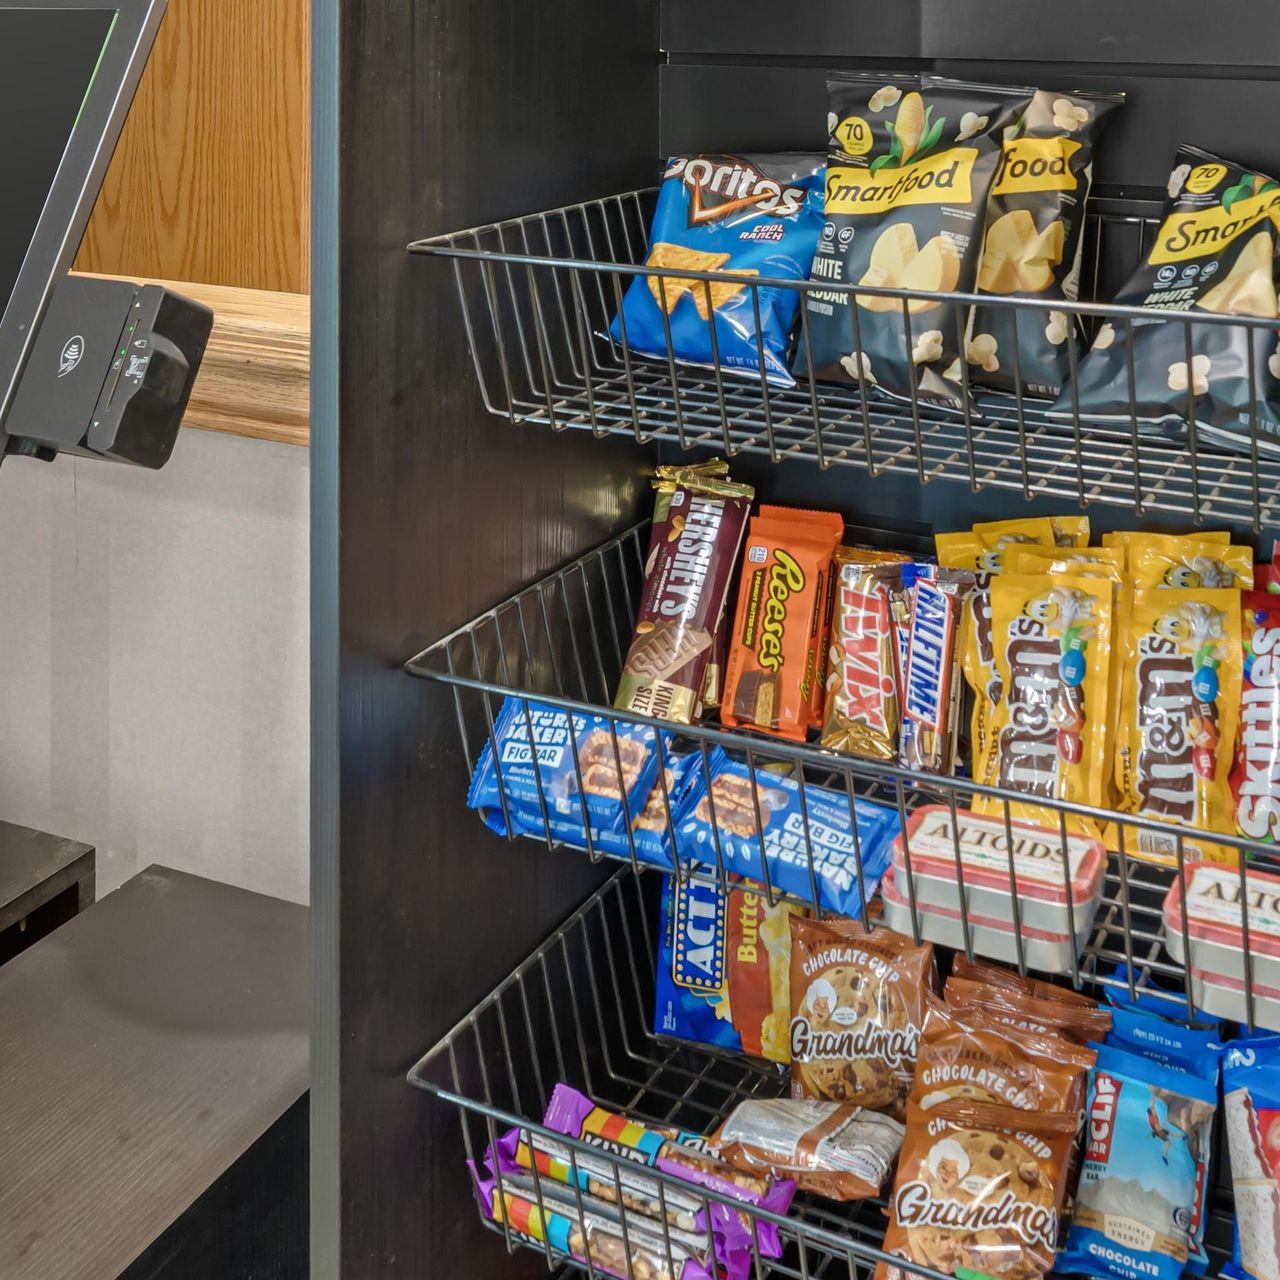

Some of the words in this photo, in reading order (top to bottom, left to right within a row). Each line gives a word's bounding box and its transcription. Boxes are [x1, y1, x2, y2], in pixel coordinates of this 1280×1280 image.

[845, 123, 864, 140] 70
[664, 158, 805, 214] Doritos
[827, 160, 961, 204] Smartfood
[1194, 168, 1220, 179] 70
[739, 232, 783, 241] RANCH
[752, 224, 784, 232] COOL
[1145, 287, 1199, 304] WHITE
[660, 496, 725, 620] HERSHEY'S
[758, 548, 805, 672] Reese's
[906, 583, 946, 726] HALFTIME
[631, 686, 652, 713] SIZE
[651, 681, 674, 719] KING
[507, 746, 530, 761] FIG
[791, 818, 825, 838] BR
[686, 896, 716, 975] ACT
[737, 879, 759, 963] Butter
[803, 948, 874, 977] CHOCOLATE
[868, 955, 901, 983] CHIP
[790, 1017, 920, 1067] Grandma's
[922, 1065, 1005, 1092] CHOCOLATE
[1091, 1077, 1117, 1141] CLIF
[1015, 1129, 1052, 1159] CHIP
[896, 1181, 1058, 1252] Grandma's
[1089, 1243, 1159, 1277] CHOCOLATE
